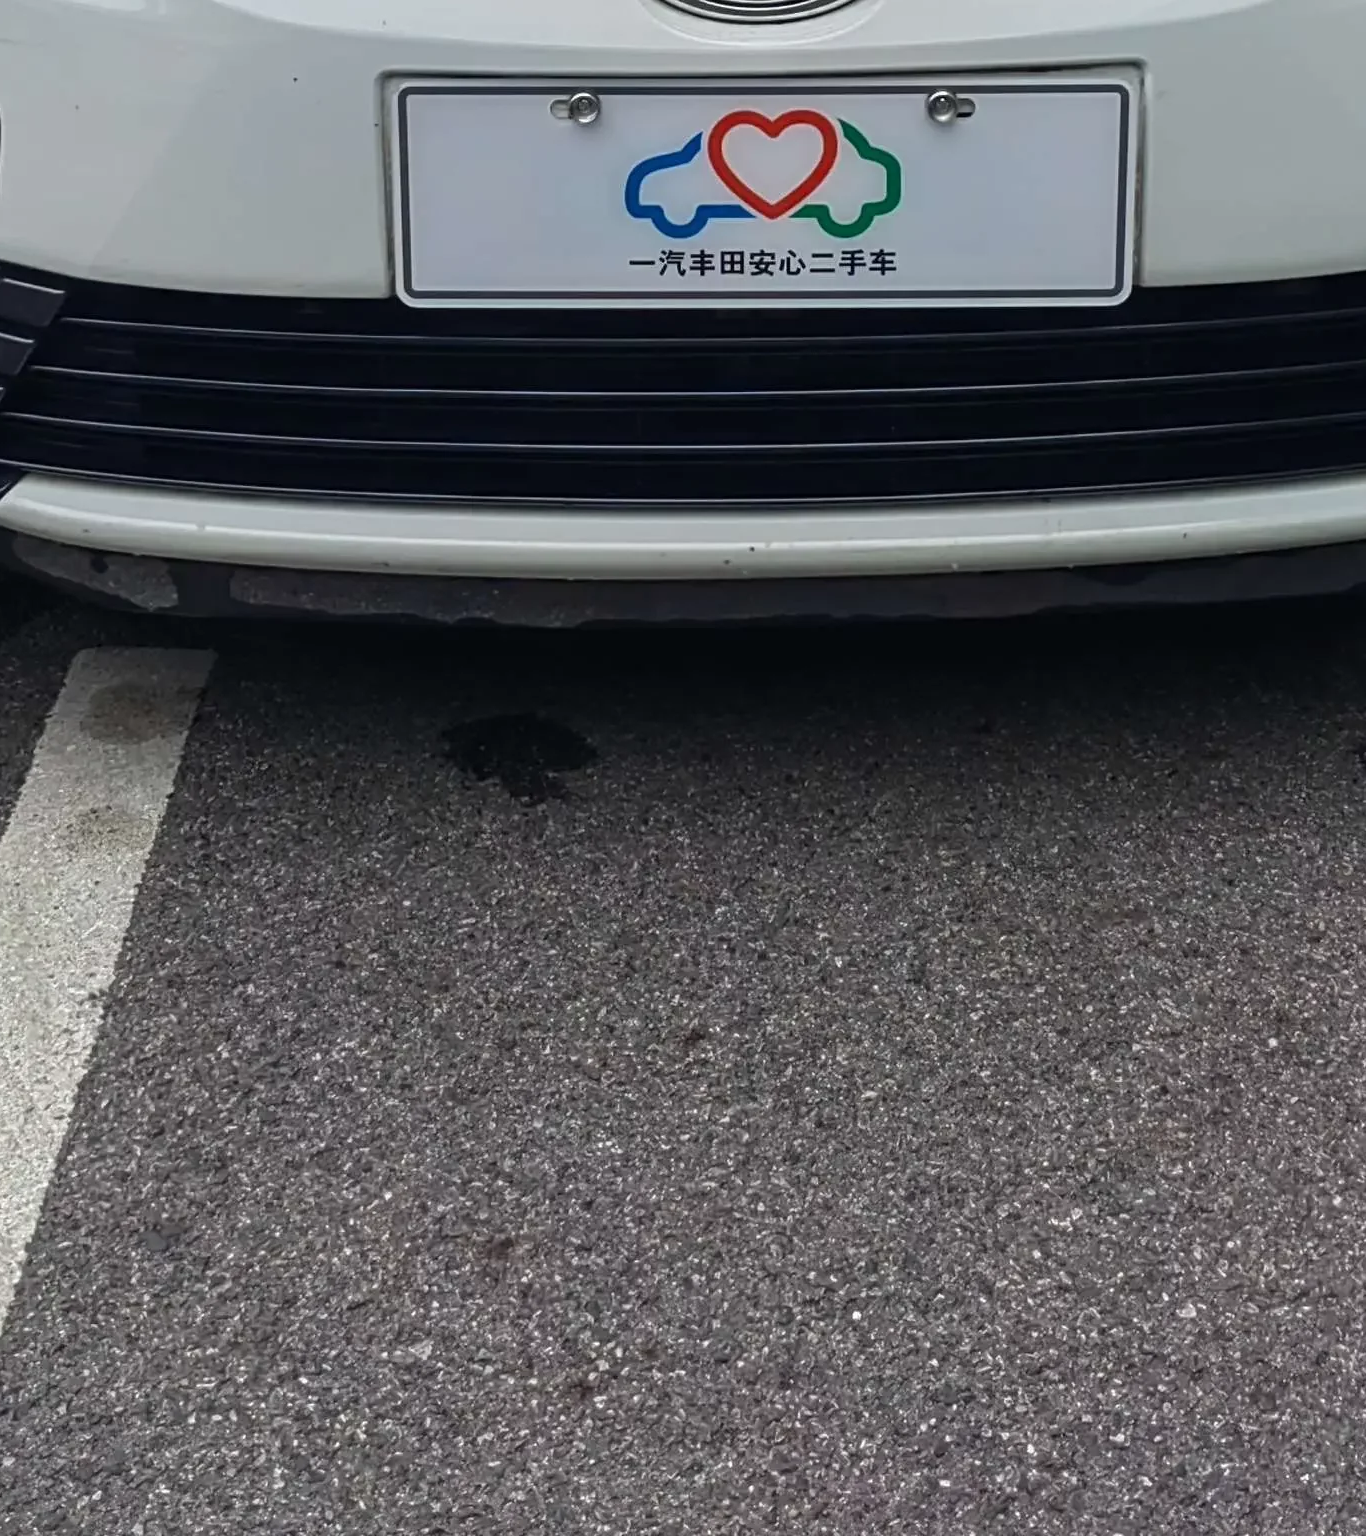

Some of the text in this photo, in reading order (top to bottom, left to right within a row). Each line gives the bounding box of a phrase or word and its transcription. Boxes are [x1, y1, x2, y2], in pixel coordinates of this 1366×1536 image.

[629, 249, 897, 277] 一汽丰田安心二手车
